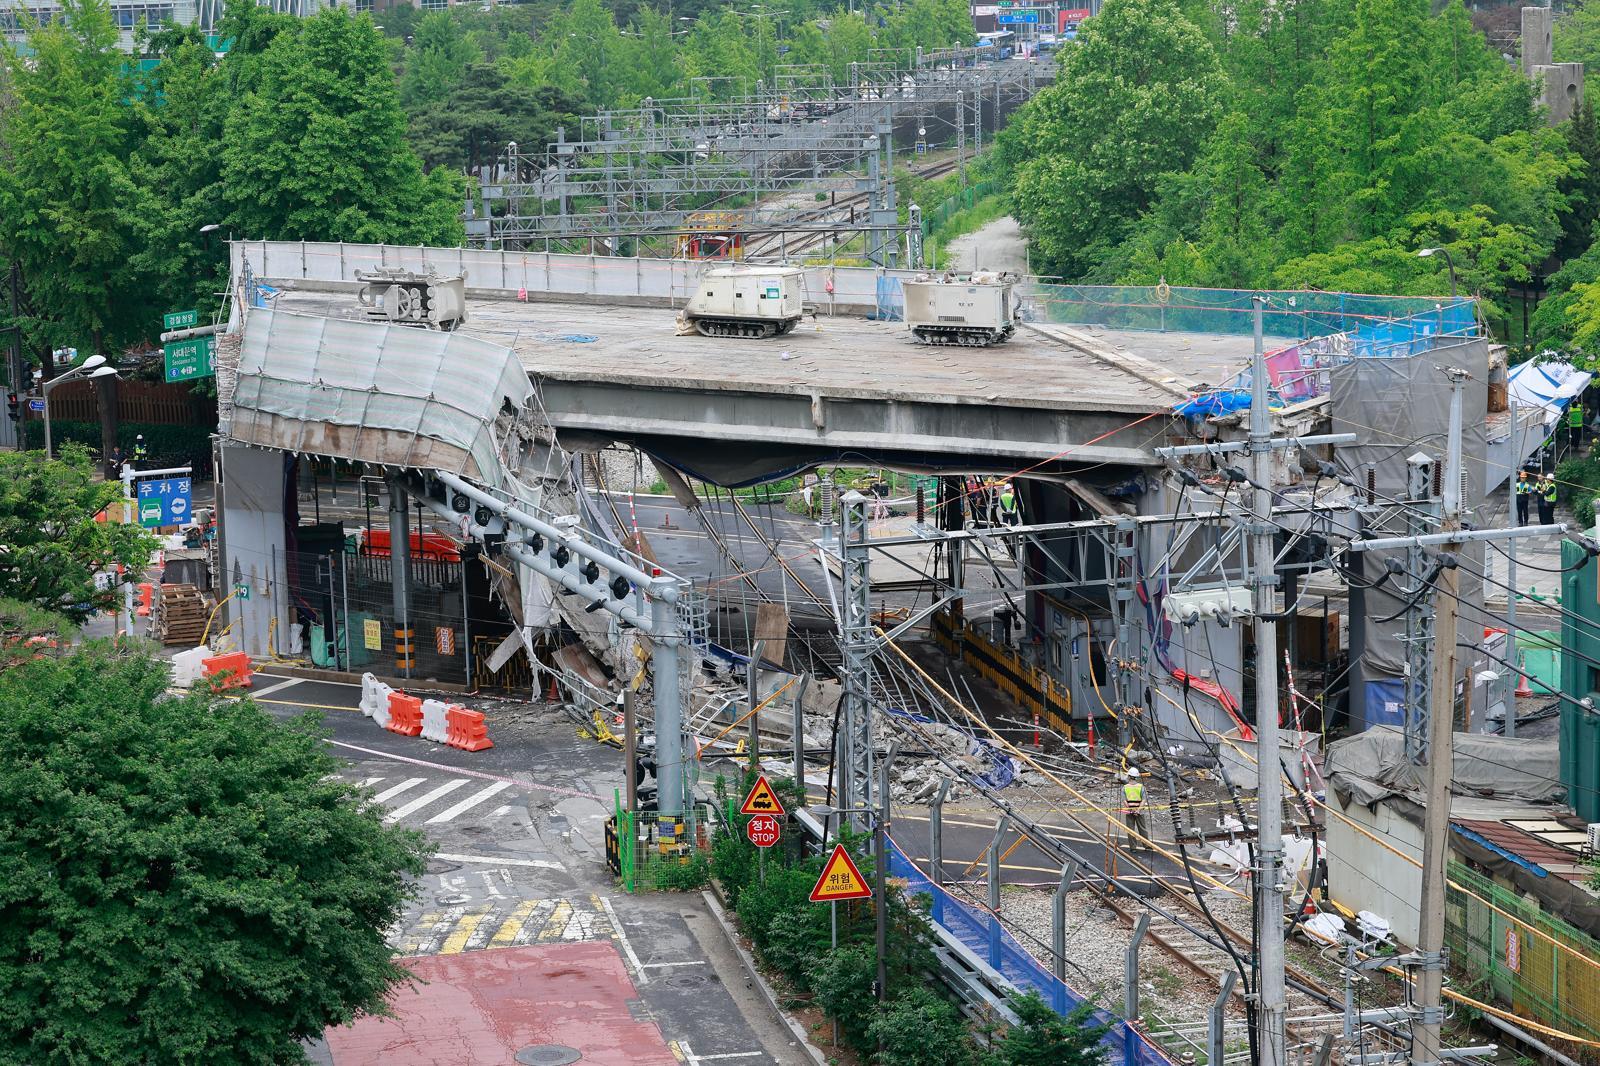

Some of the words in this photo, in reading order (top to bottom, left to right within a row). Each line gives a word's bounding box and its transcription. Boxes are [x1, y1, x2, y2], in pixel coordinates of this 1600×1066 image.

[169, 313, 193, 326] 경찰청앞
[172, 345, 197, 358] 서대문역
[752, 820, 775, 831] 정지
[752, 833, 775, 842] STOP
[829, 872, 850, 885] 위험
[825, 883, 854, 892] DANGER
